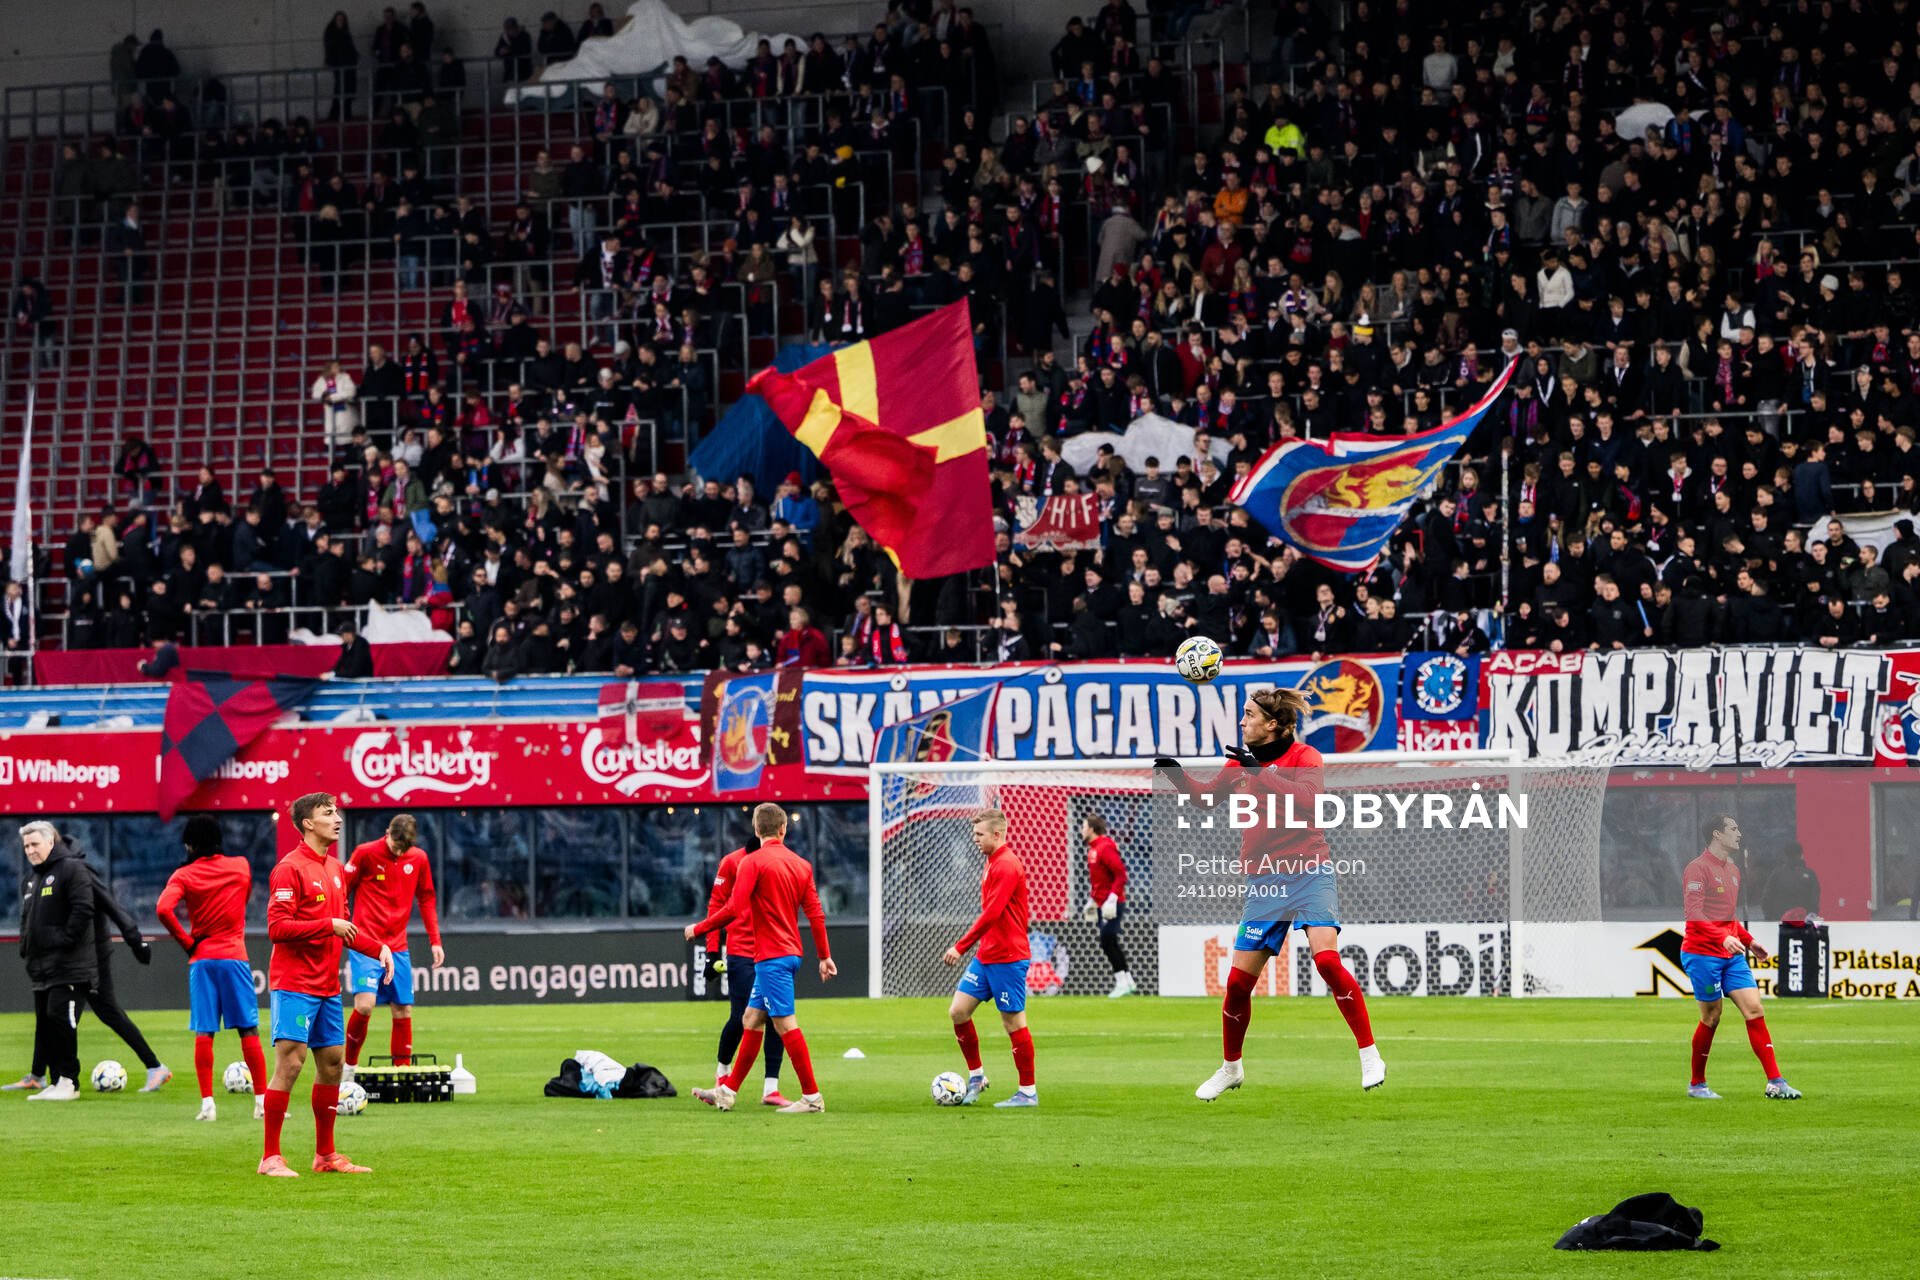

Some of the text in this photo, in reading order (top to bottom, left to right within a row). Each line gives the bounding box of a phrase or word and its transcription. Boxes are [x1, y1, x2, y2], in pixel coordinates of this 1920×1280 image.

[1187, 654, 1202, 678] SELECT
[1490, 652, 1583, 674] ACAB
[803, 666, 1276, 764] SKÅ PÅGARN
[1488, 649, 1889, 760] KOMPANIET
[17, 759, 120, 788] Wihlborgs
[351, 732, 492, 800] Carlsberg
[581, 727, 710, 796] Carlsber
[1246, 926, 1263, 936] Solid
[1789, 938, 1803, 992] SELECT
